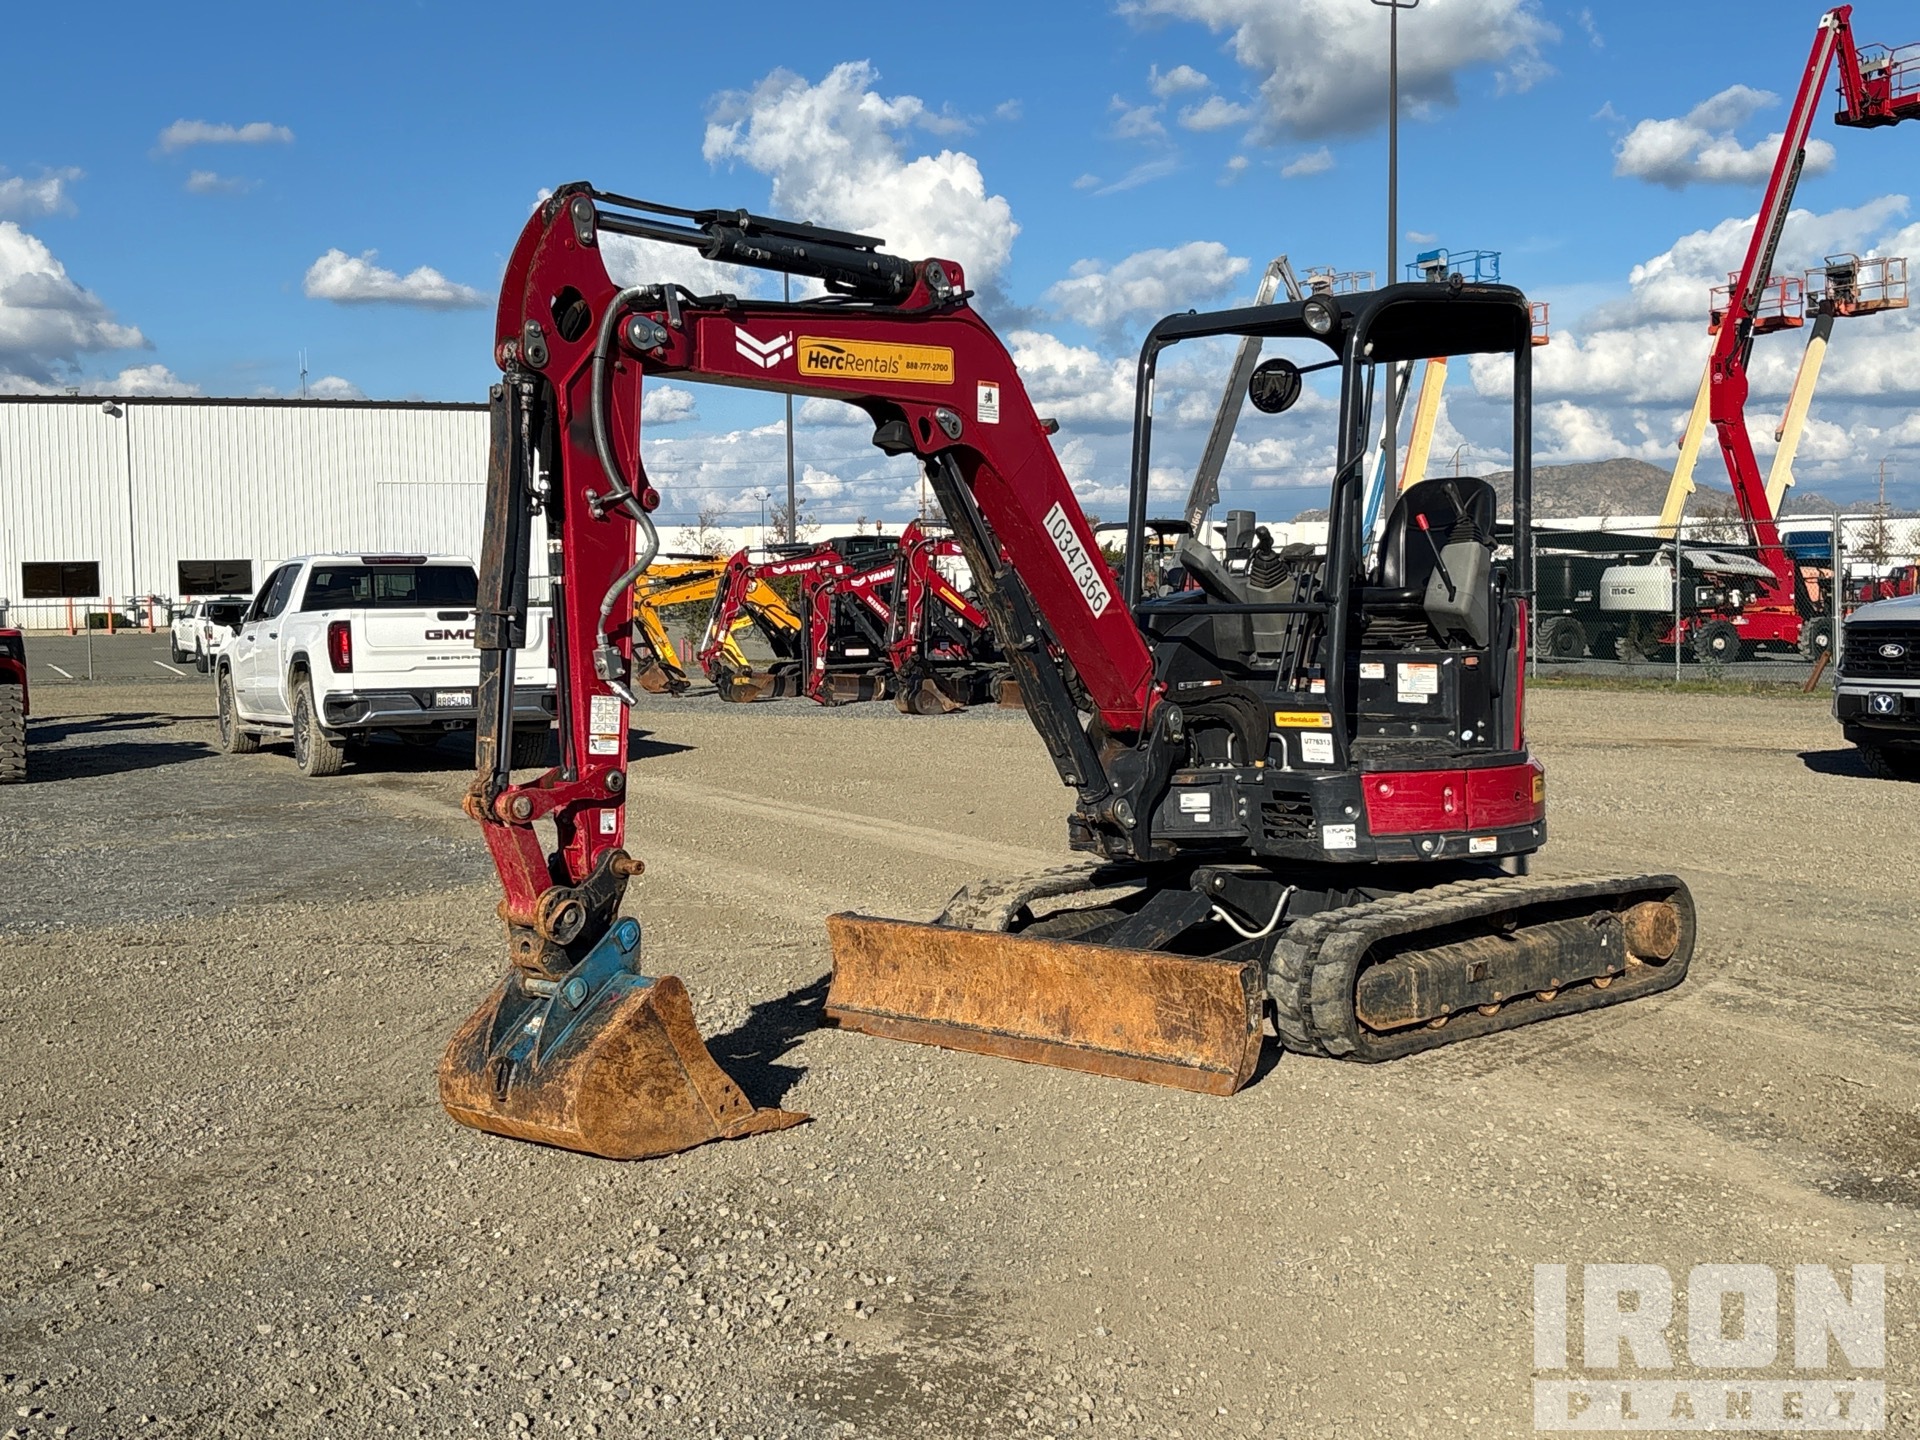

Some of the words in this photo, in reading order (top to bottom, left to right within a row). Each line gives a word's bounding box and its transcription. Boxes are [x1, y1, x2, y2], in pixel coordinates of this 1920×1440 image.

[806, 350, 899, 374] HercRentals
[905, 361, 948, 372] 888-777-2700
[1046, 505, 1107, 612] 10347366
